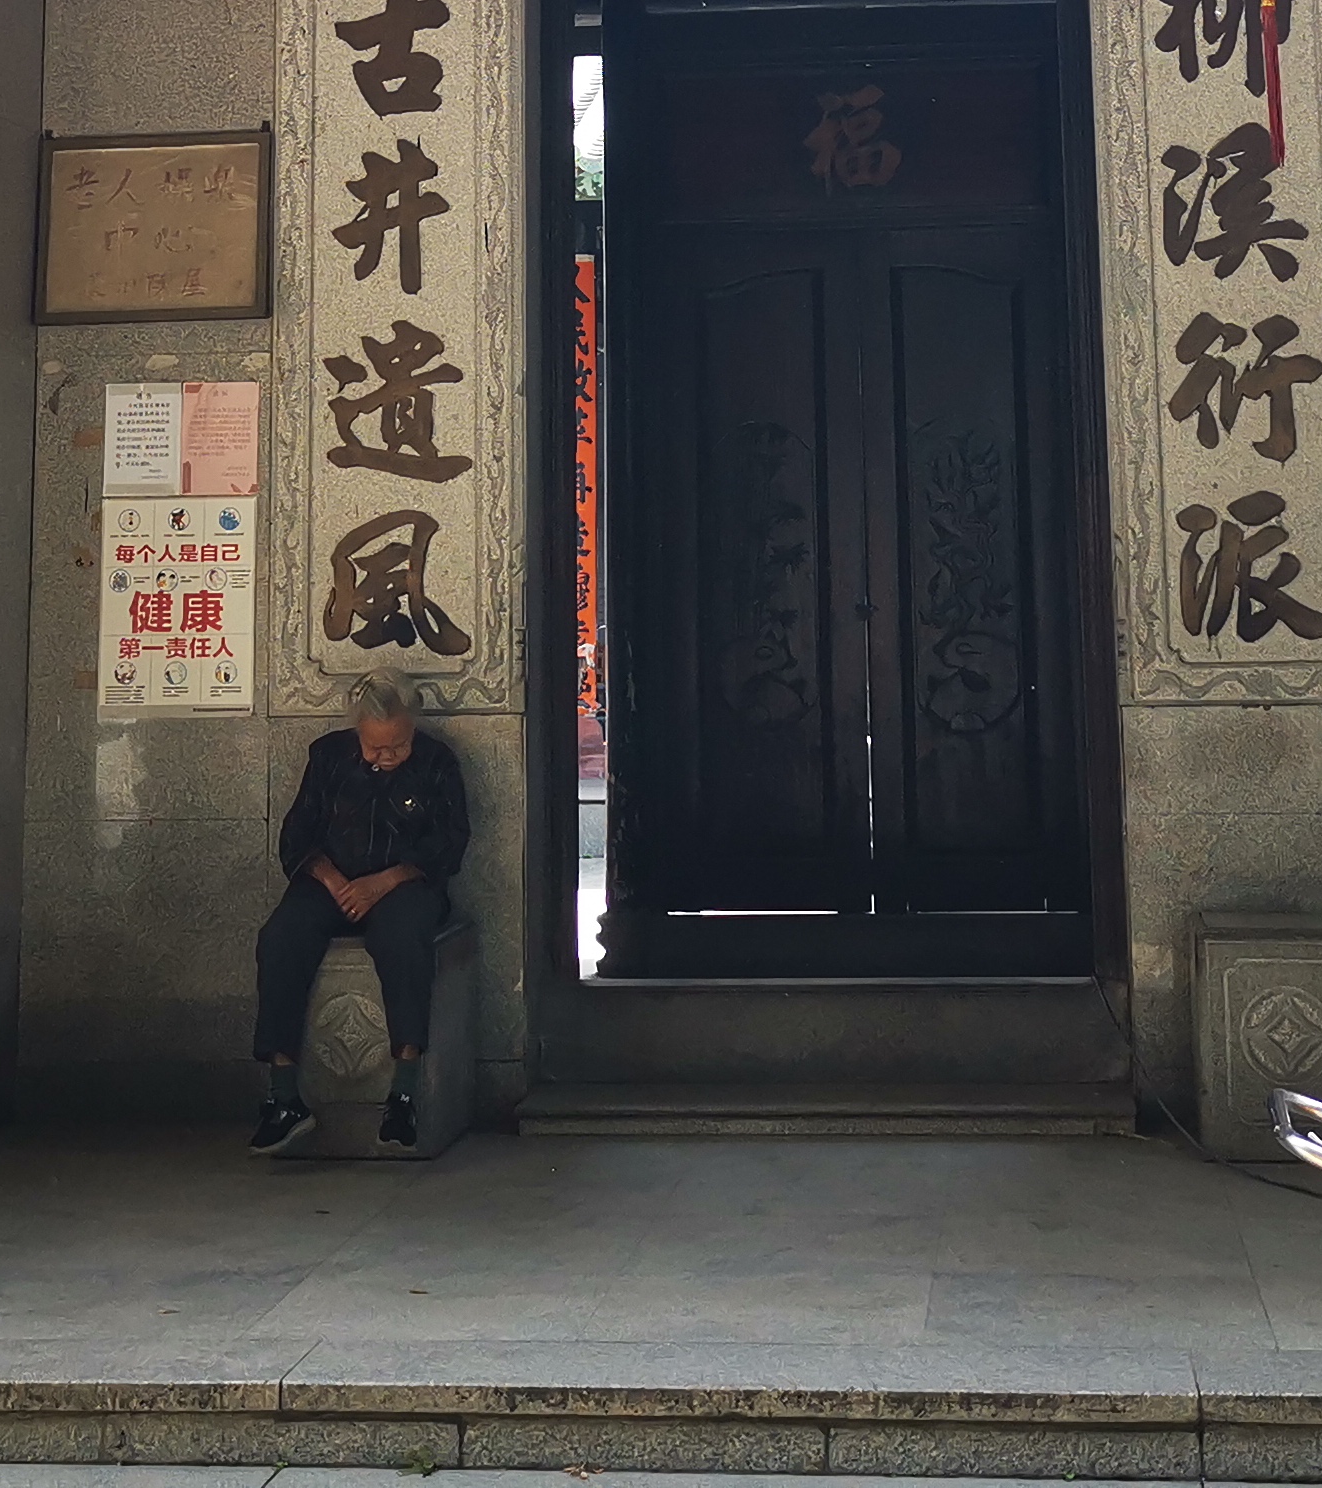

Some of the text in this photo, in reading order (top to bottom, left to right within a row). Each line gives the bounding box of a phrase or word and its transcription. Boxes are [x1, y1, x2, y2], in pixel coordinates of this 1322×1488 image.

[115, 543, 241, 564] 每个人是自己
[129, 590, 224, 633] 健康
[118, 637, 234, 659] 第一责任人
